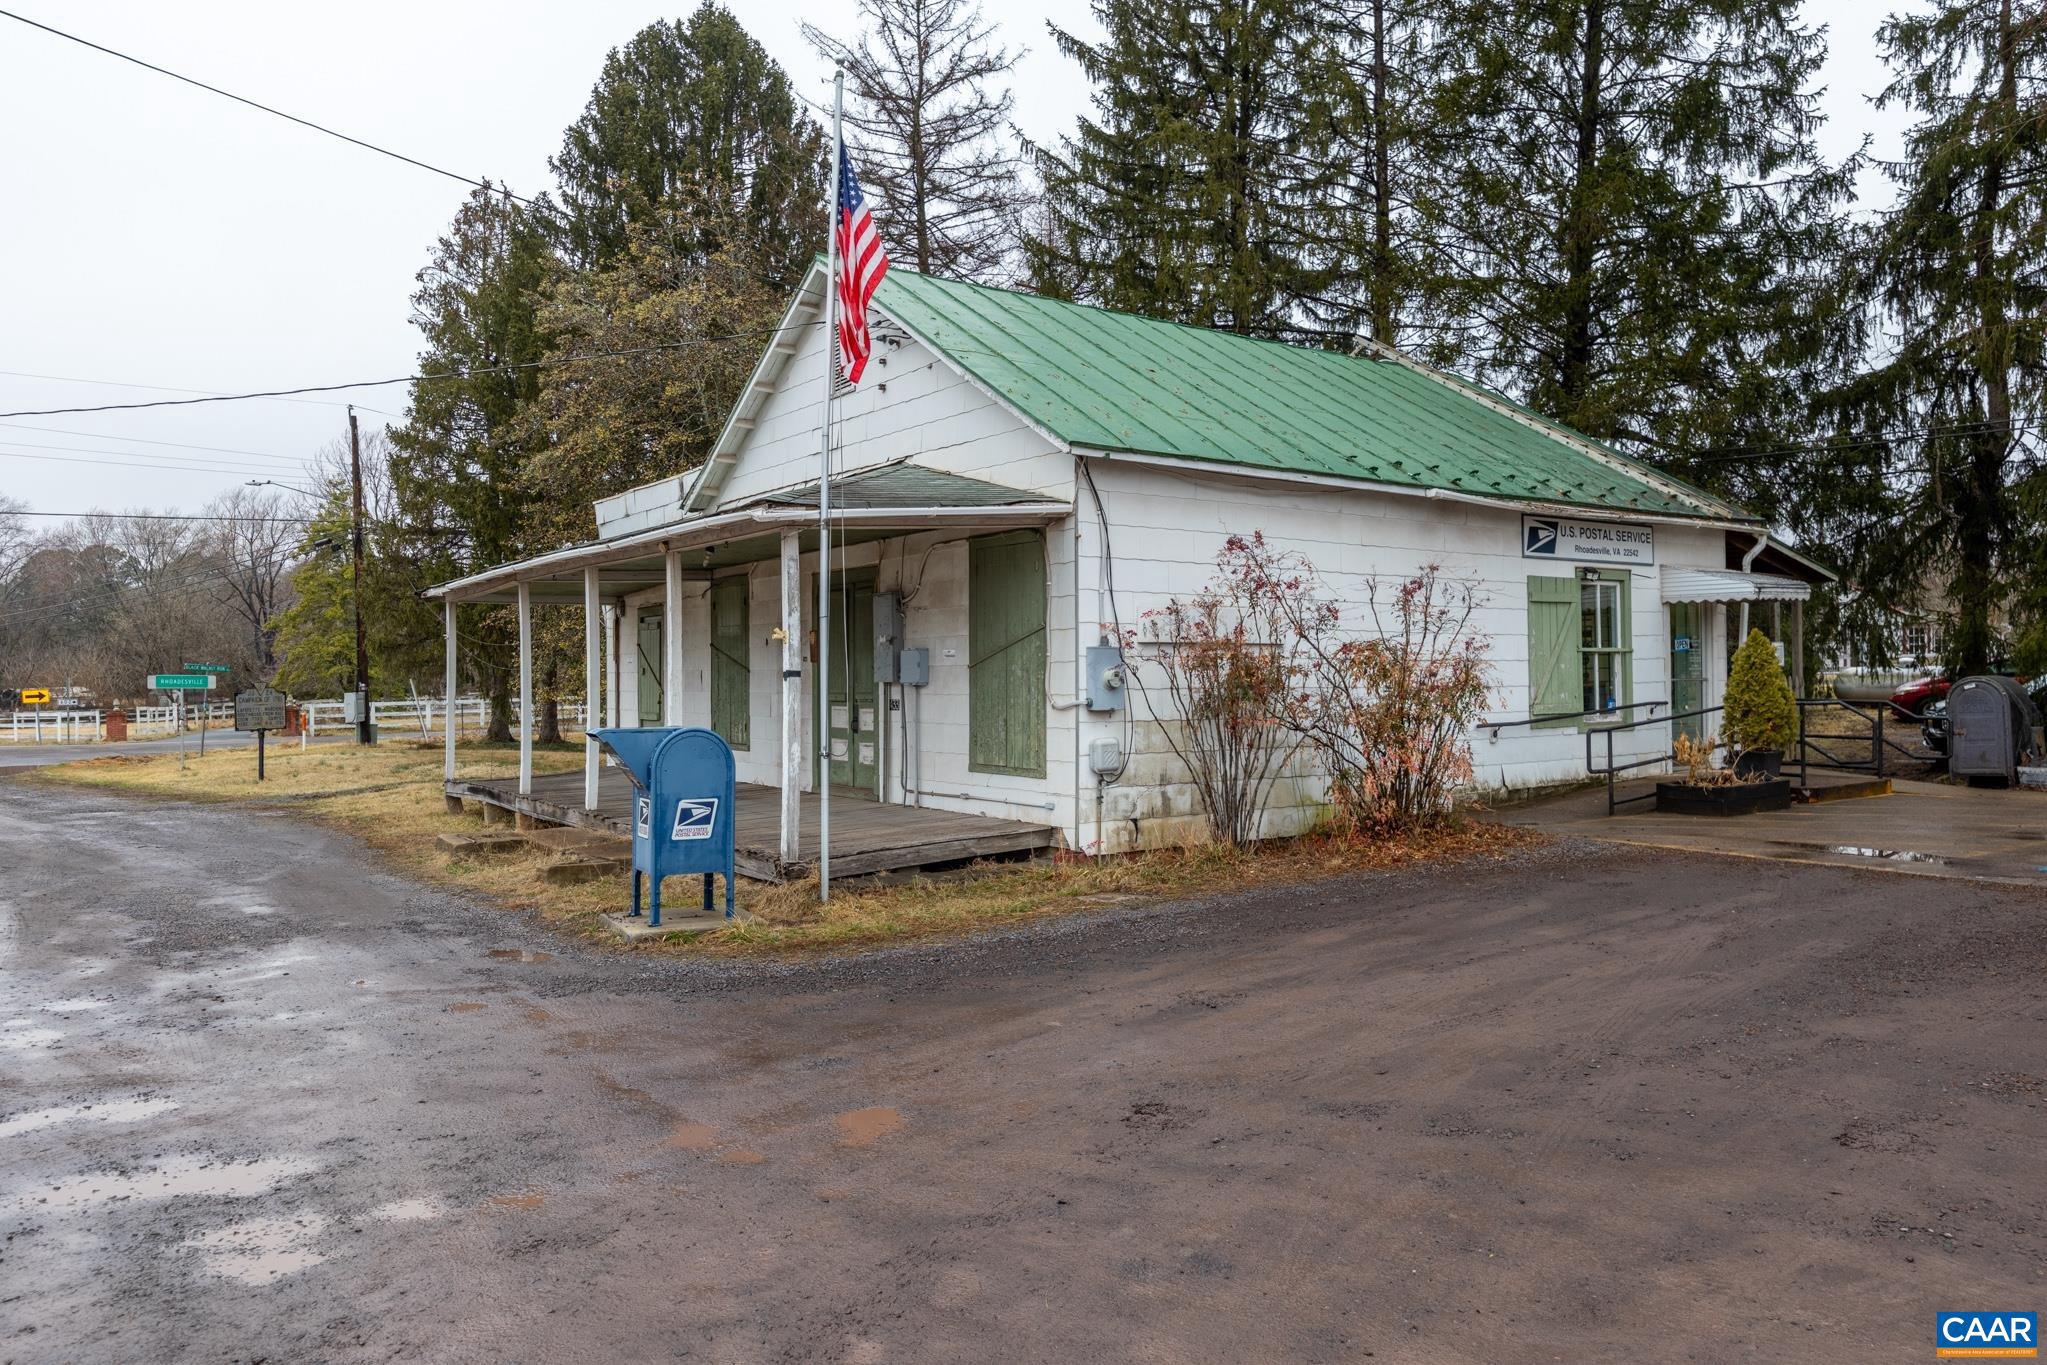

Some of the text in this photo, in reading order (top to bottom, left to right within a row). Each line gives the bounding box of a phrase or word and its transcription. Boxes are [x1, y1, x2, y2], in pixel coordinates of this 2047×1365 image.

[1560, 526, 1651, 544] U.S. POSTAL SERVICE
[1575, 545, 1612, 556] Rhoadesville,
[1623, 548, 1639, 557] 22542
[1676, 640, 1689, 649] OPEN
